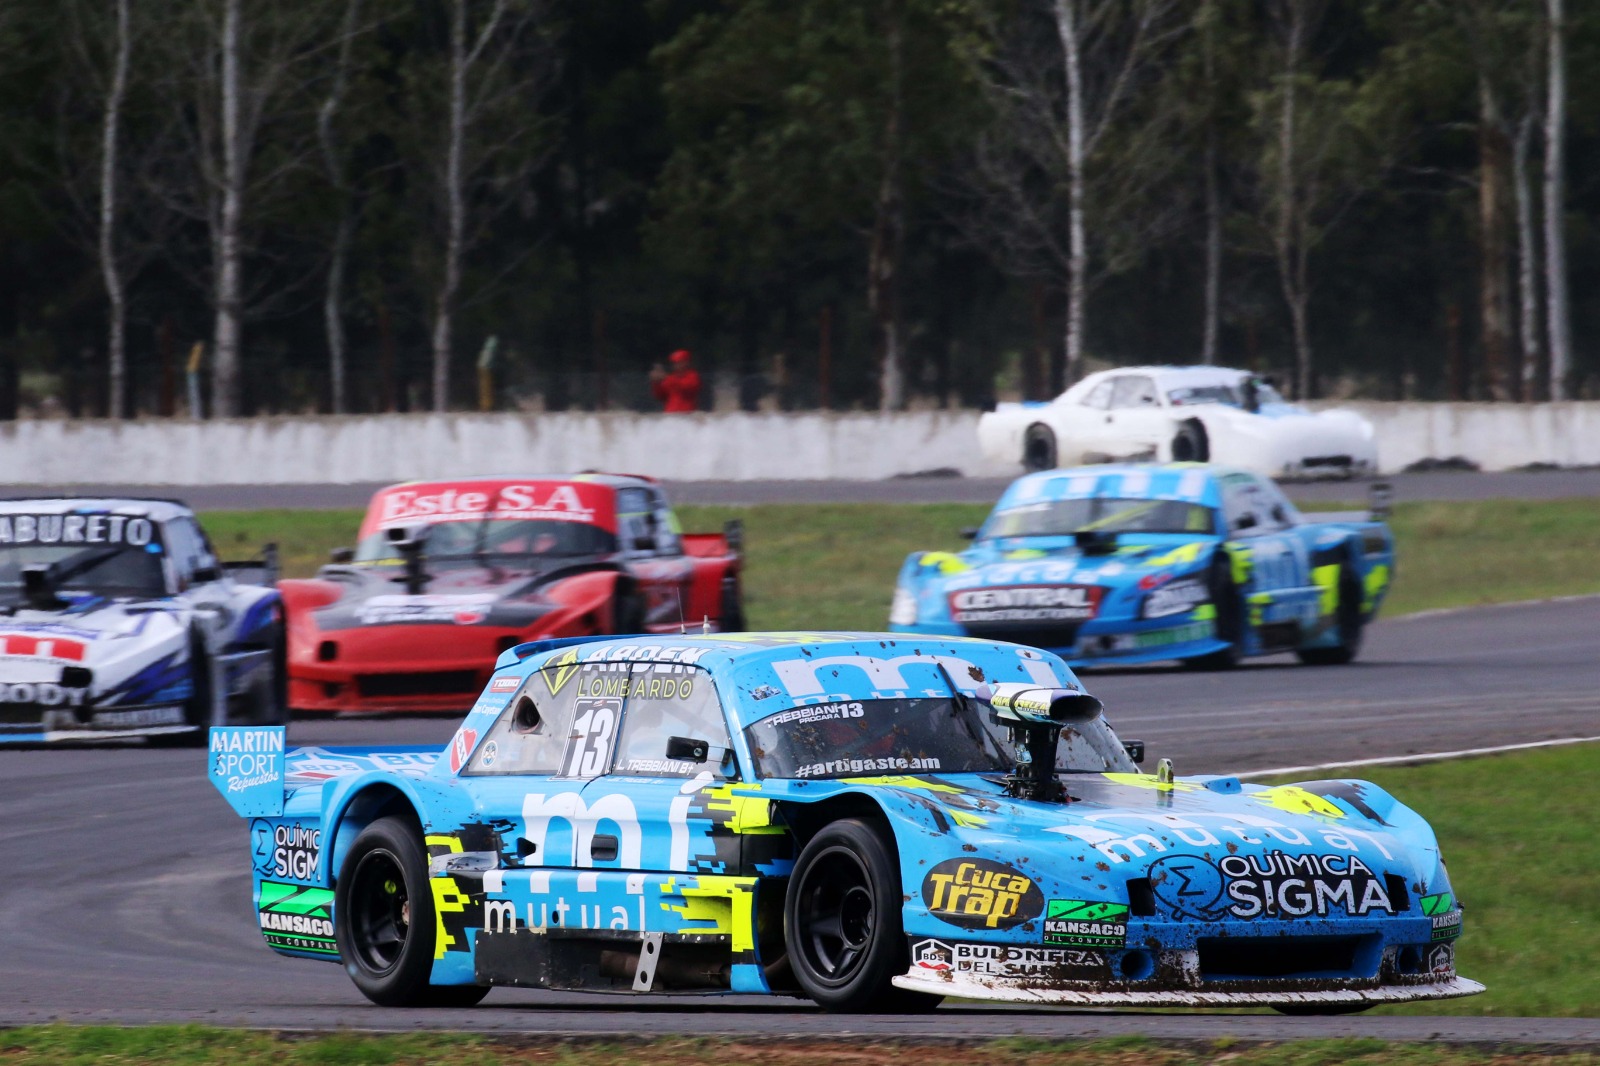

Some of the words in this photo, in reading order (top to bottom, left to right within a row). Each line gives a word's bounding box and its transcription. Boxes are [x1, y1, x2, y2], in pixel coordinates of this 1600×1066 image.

[381, 486, 490, 519] Este
[497, 484, 596, 513] S.A.
[581, 645, 712, 675] ARDEN
[577, 678, 693, 698] LOMBARDO
[764, 703, 838, 729] TREBBIANI
[838, 702, 864, 719] 13
[210, 730, 283, 753] MARTIN
[568, 707, 614, 777] 13
[216, 753, 277, 776] SPORT
[628, 759, 680, 774] TREBBIANI
[795, 756, 941, 778] #artigasteam
[227, 771, 280, 793] Repuestos
[1095, 824, 1394, 864] mutual
[1221, 850, 1373, 877] QUÍMICA
[955, 862, 1031, 894] Cuca
[929, 873, 1021, 928] Trap
[1229, 878, 1395, 917] SIGMA
[259, 912, 334, 937] KANSACO
[484, 895, 646, 940] mutual
[1044, 920, 1126, 936] KANSACO
[286, 937, 338, 951] COMPANY
[923, 952, 945, 961] BDS
[957, 960, 996, 975] DEL
